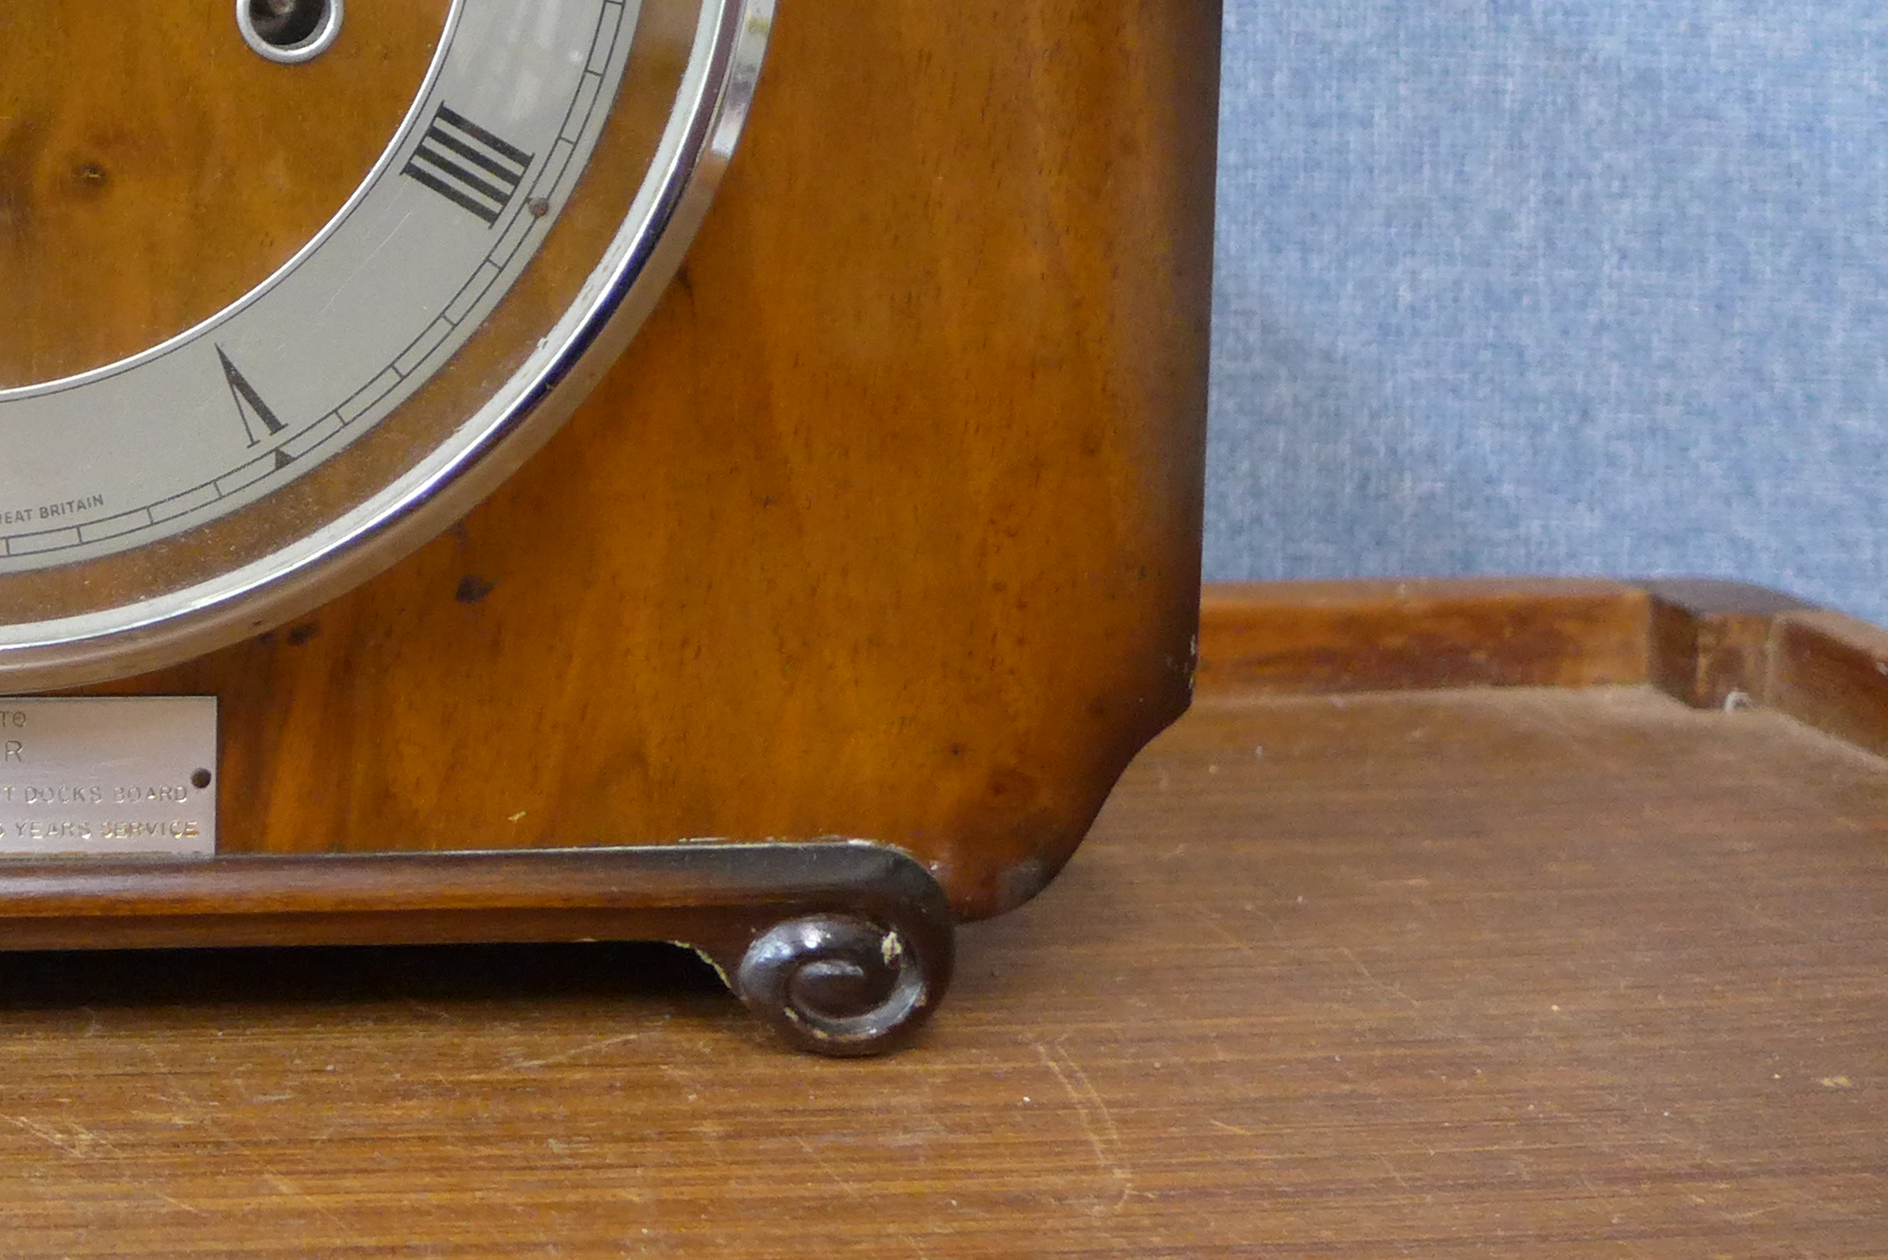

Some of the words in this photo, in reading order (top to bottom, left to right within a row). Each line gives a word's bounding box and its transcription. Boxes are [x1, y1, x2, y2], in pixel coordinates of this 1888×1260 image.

[399, 100, 535, 230] IIII
[214, 342, 289, 449] V
[39, 494, 105, 520] BRITAIN
[0, 710, 26, 728] TO
[25, 785, 103, 804] DOCKS
[114, 785, 188, 803] BOARD
[14, 821, 91, 839] YEARS
[101, 820, 200, 839] SERVICE
